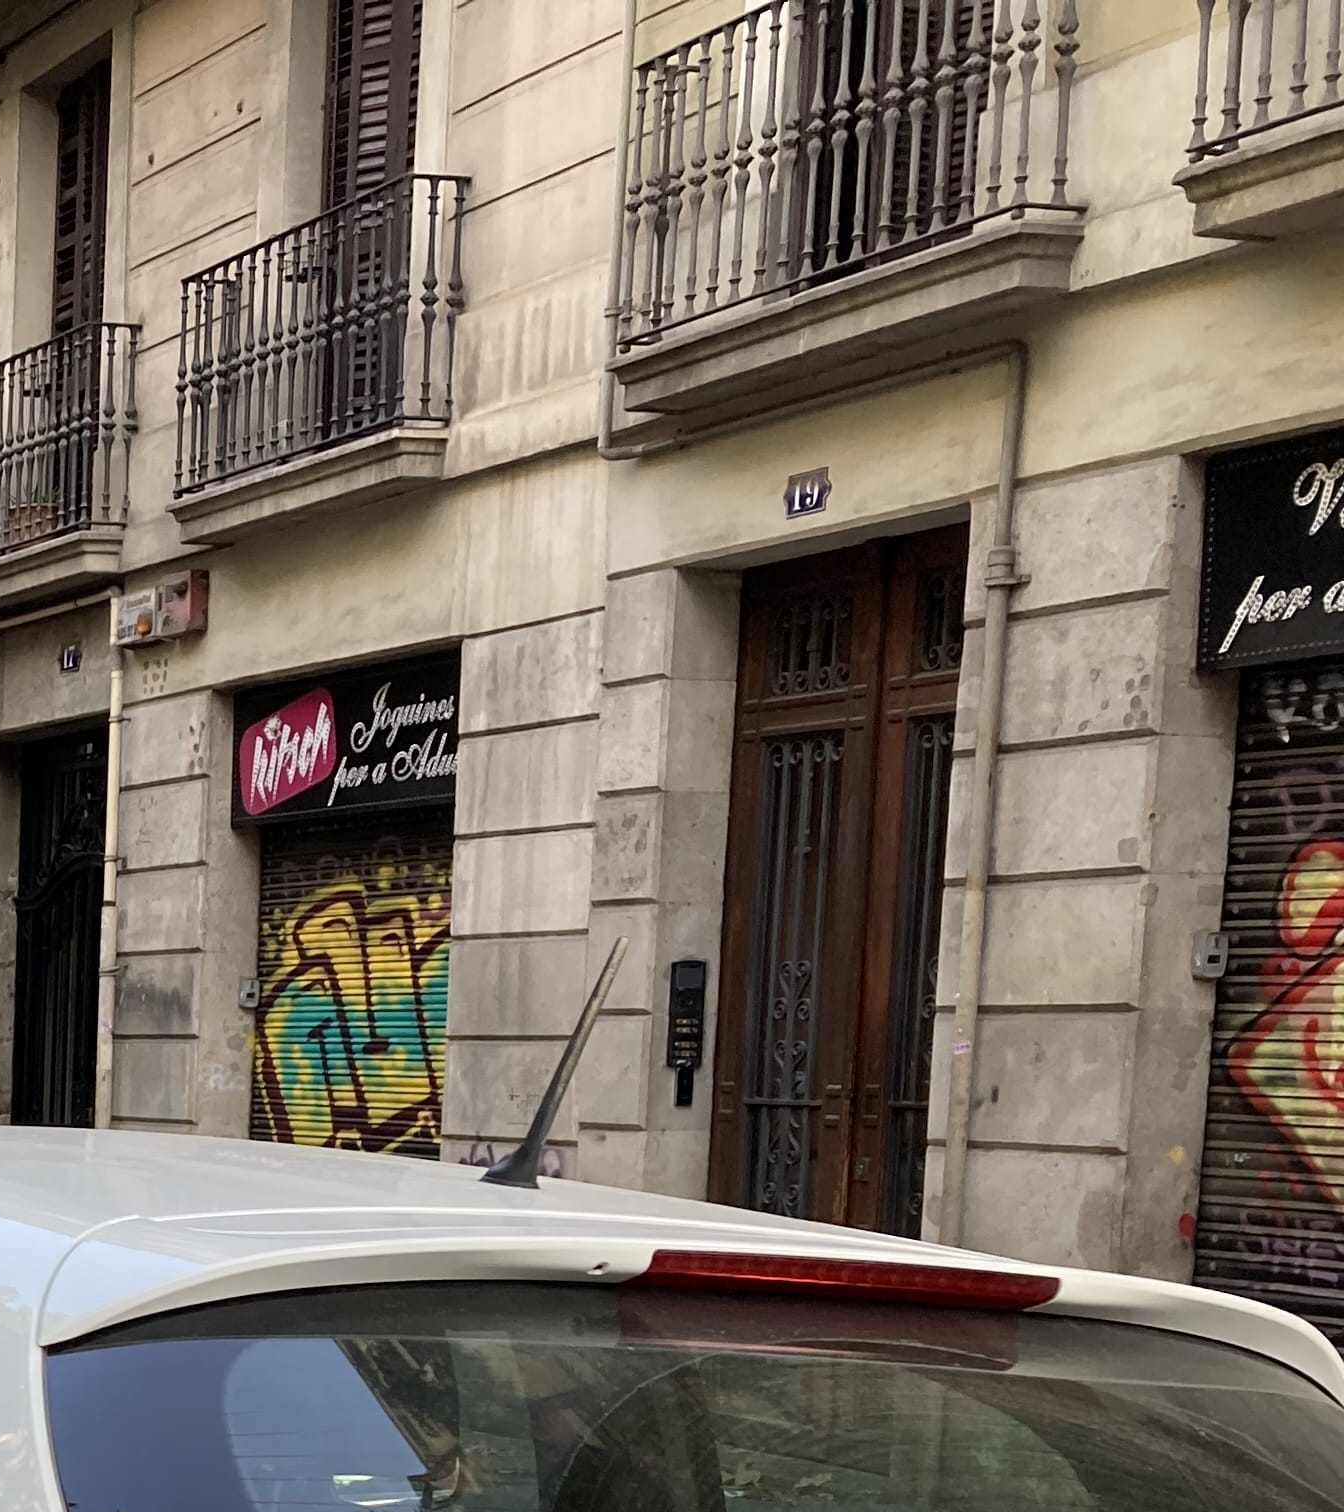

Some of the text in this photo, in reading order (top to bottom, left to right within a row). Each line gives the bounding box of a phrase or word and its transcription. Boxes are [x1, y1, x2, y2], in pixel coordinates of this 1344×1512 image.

[792, 480, 820, 511] 19
[1293, 458, 1344, 536] V
[1218, 575, 1313, 654] per
[63, 645, 76, 669] 17
[350, 682, 456, 753] Joguines
[327, 755, 370, 807] per
[371, 761, 388, 785] a
